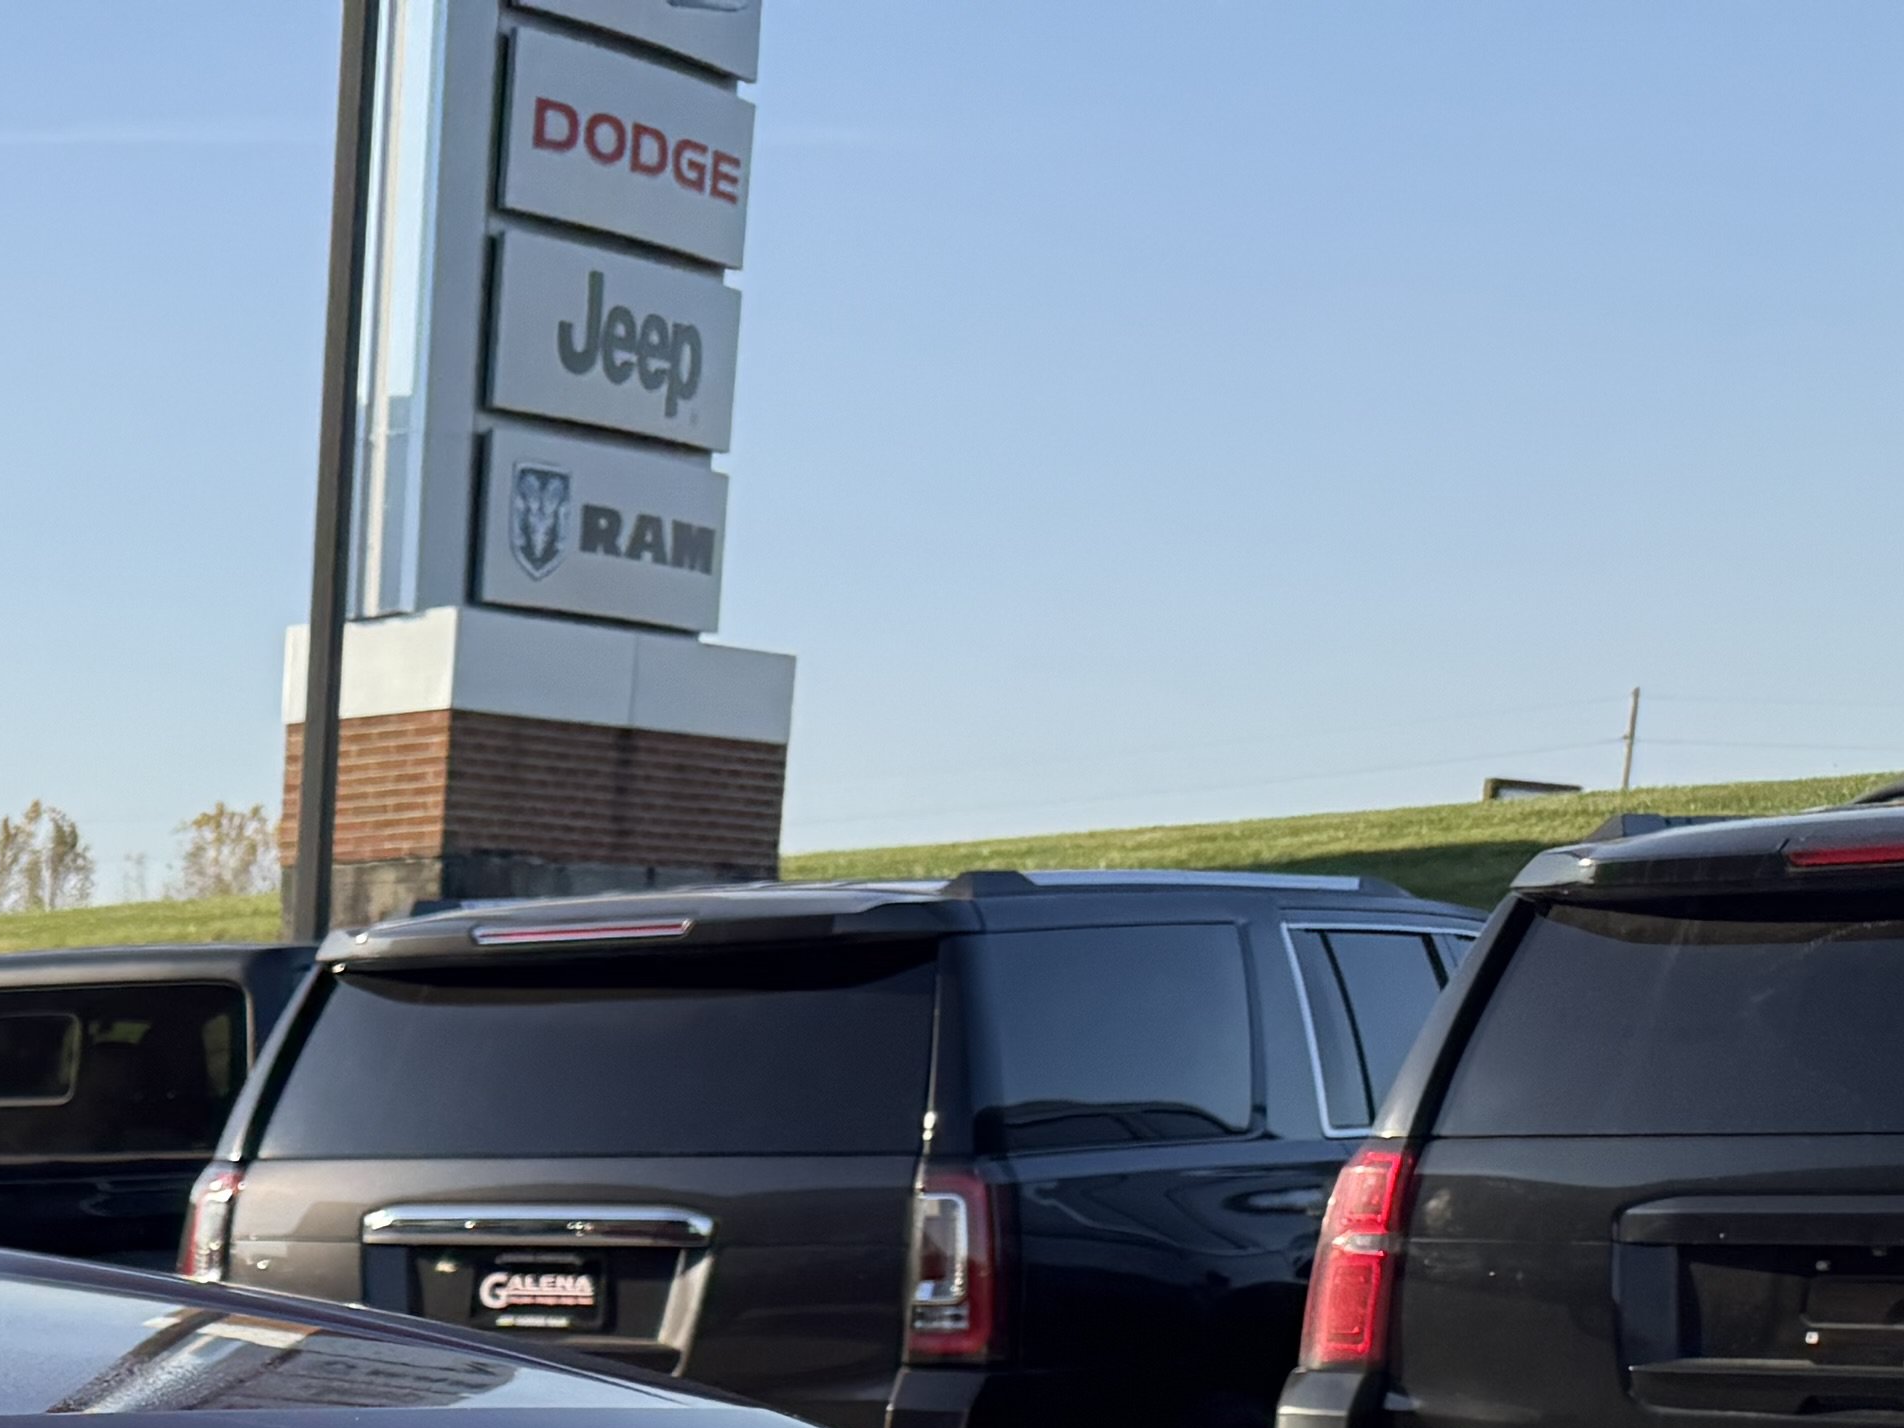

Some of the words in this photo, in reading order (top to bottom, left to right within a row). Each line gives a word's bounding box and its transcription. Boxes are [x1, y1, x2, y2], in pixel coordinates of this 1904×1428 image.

[532, 96, 741, 206] DODGE
[556, 269, 702, 418] Jeep
[578, 503, 717, 576] RAM
[479, 1271, 595, 1309] GALENA
